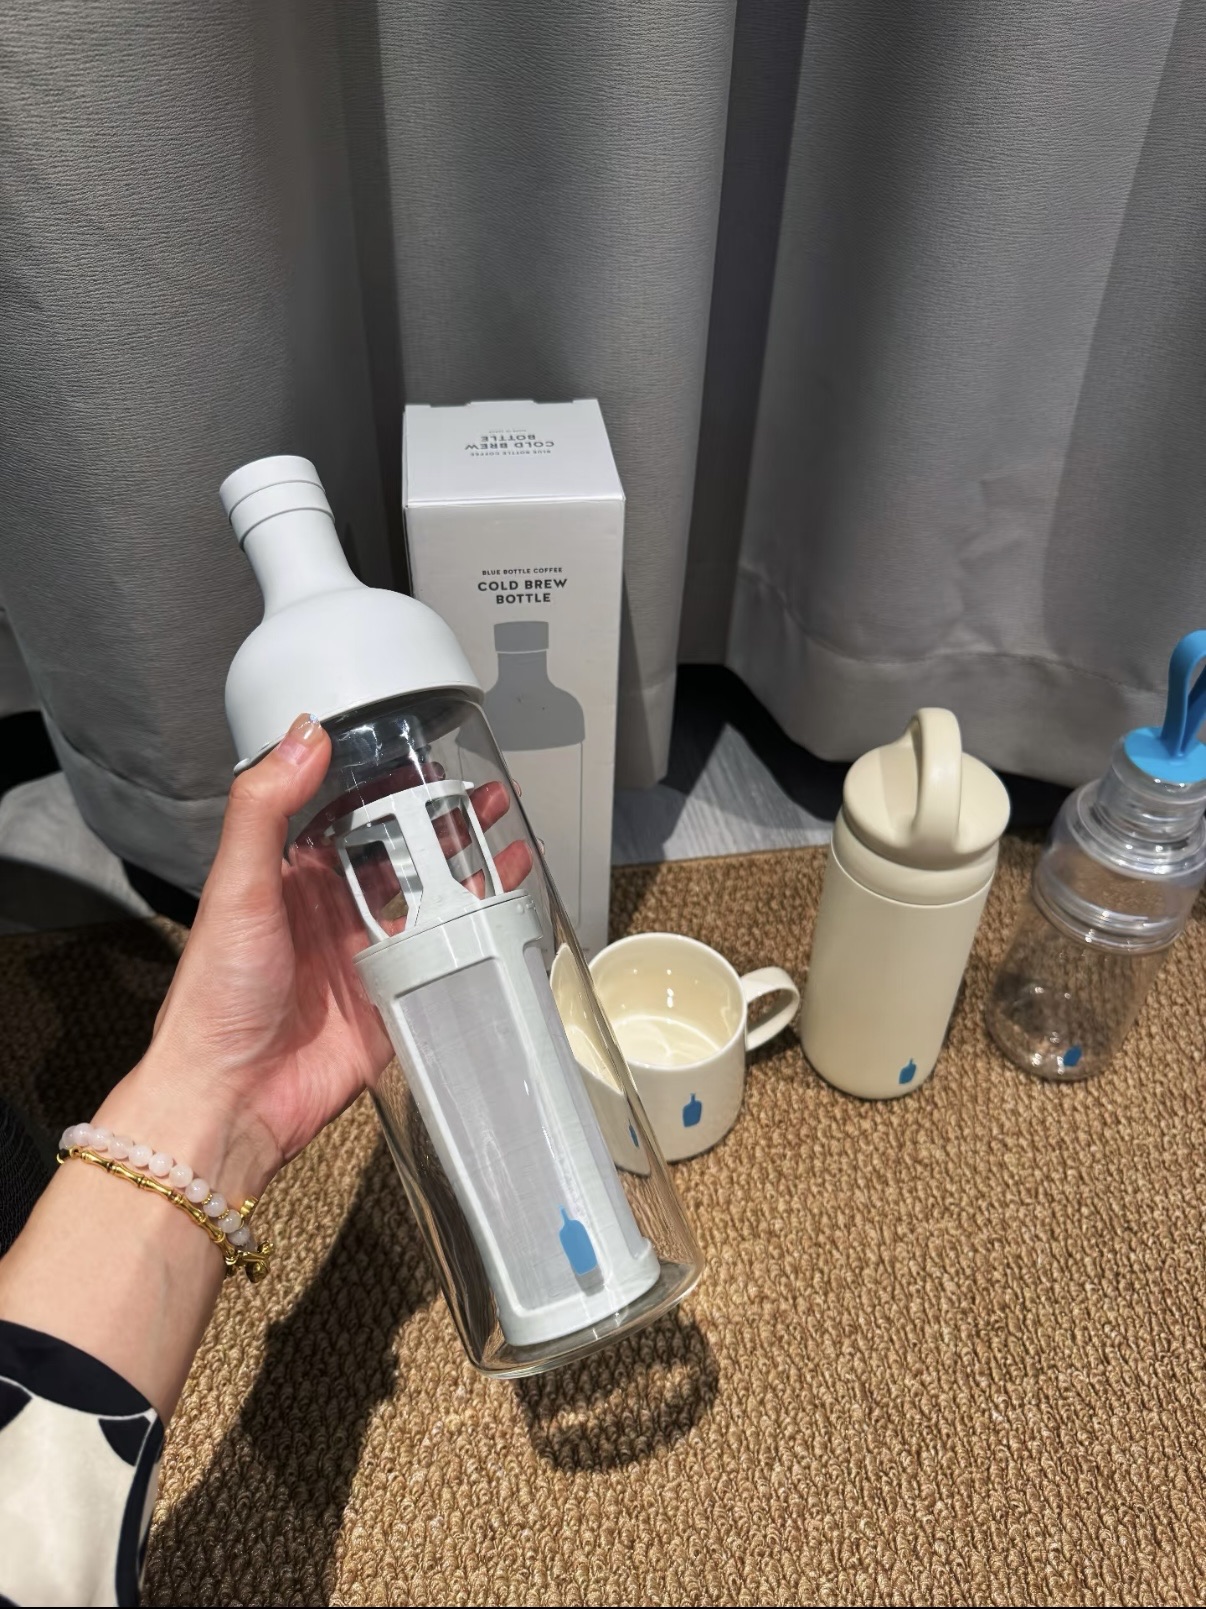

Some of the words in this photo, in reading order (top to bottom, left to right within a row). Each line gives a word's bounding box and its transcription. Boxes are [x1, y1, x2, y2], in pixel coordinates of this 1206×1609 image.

[481, 434, 536, 442] BOTTLE
[465, 442, 508, 450] BREW
[477, 580, 519, 592] COLD
[524, 578, 568, 590] BREW
[496, 592, 551, 605] BOTTLE
